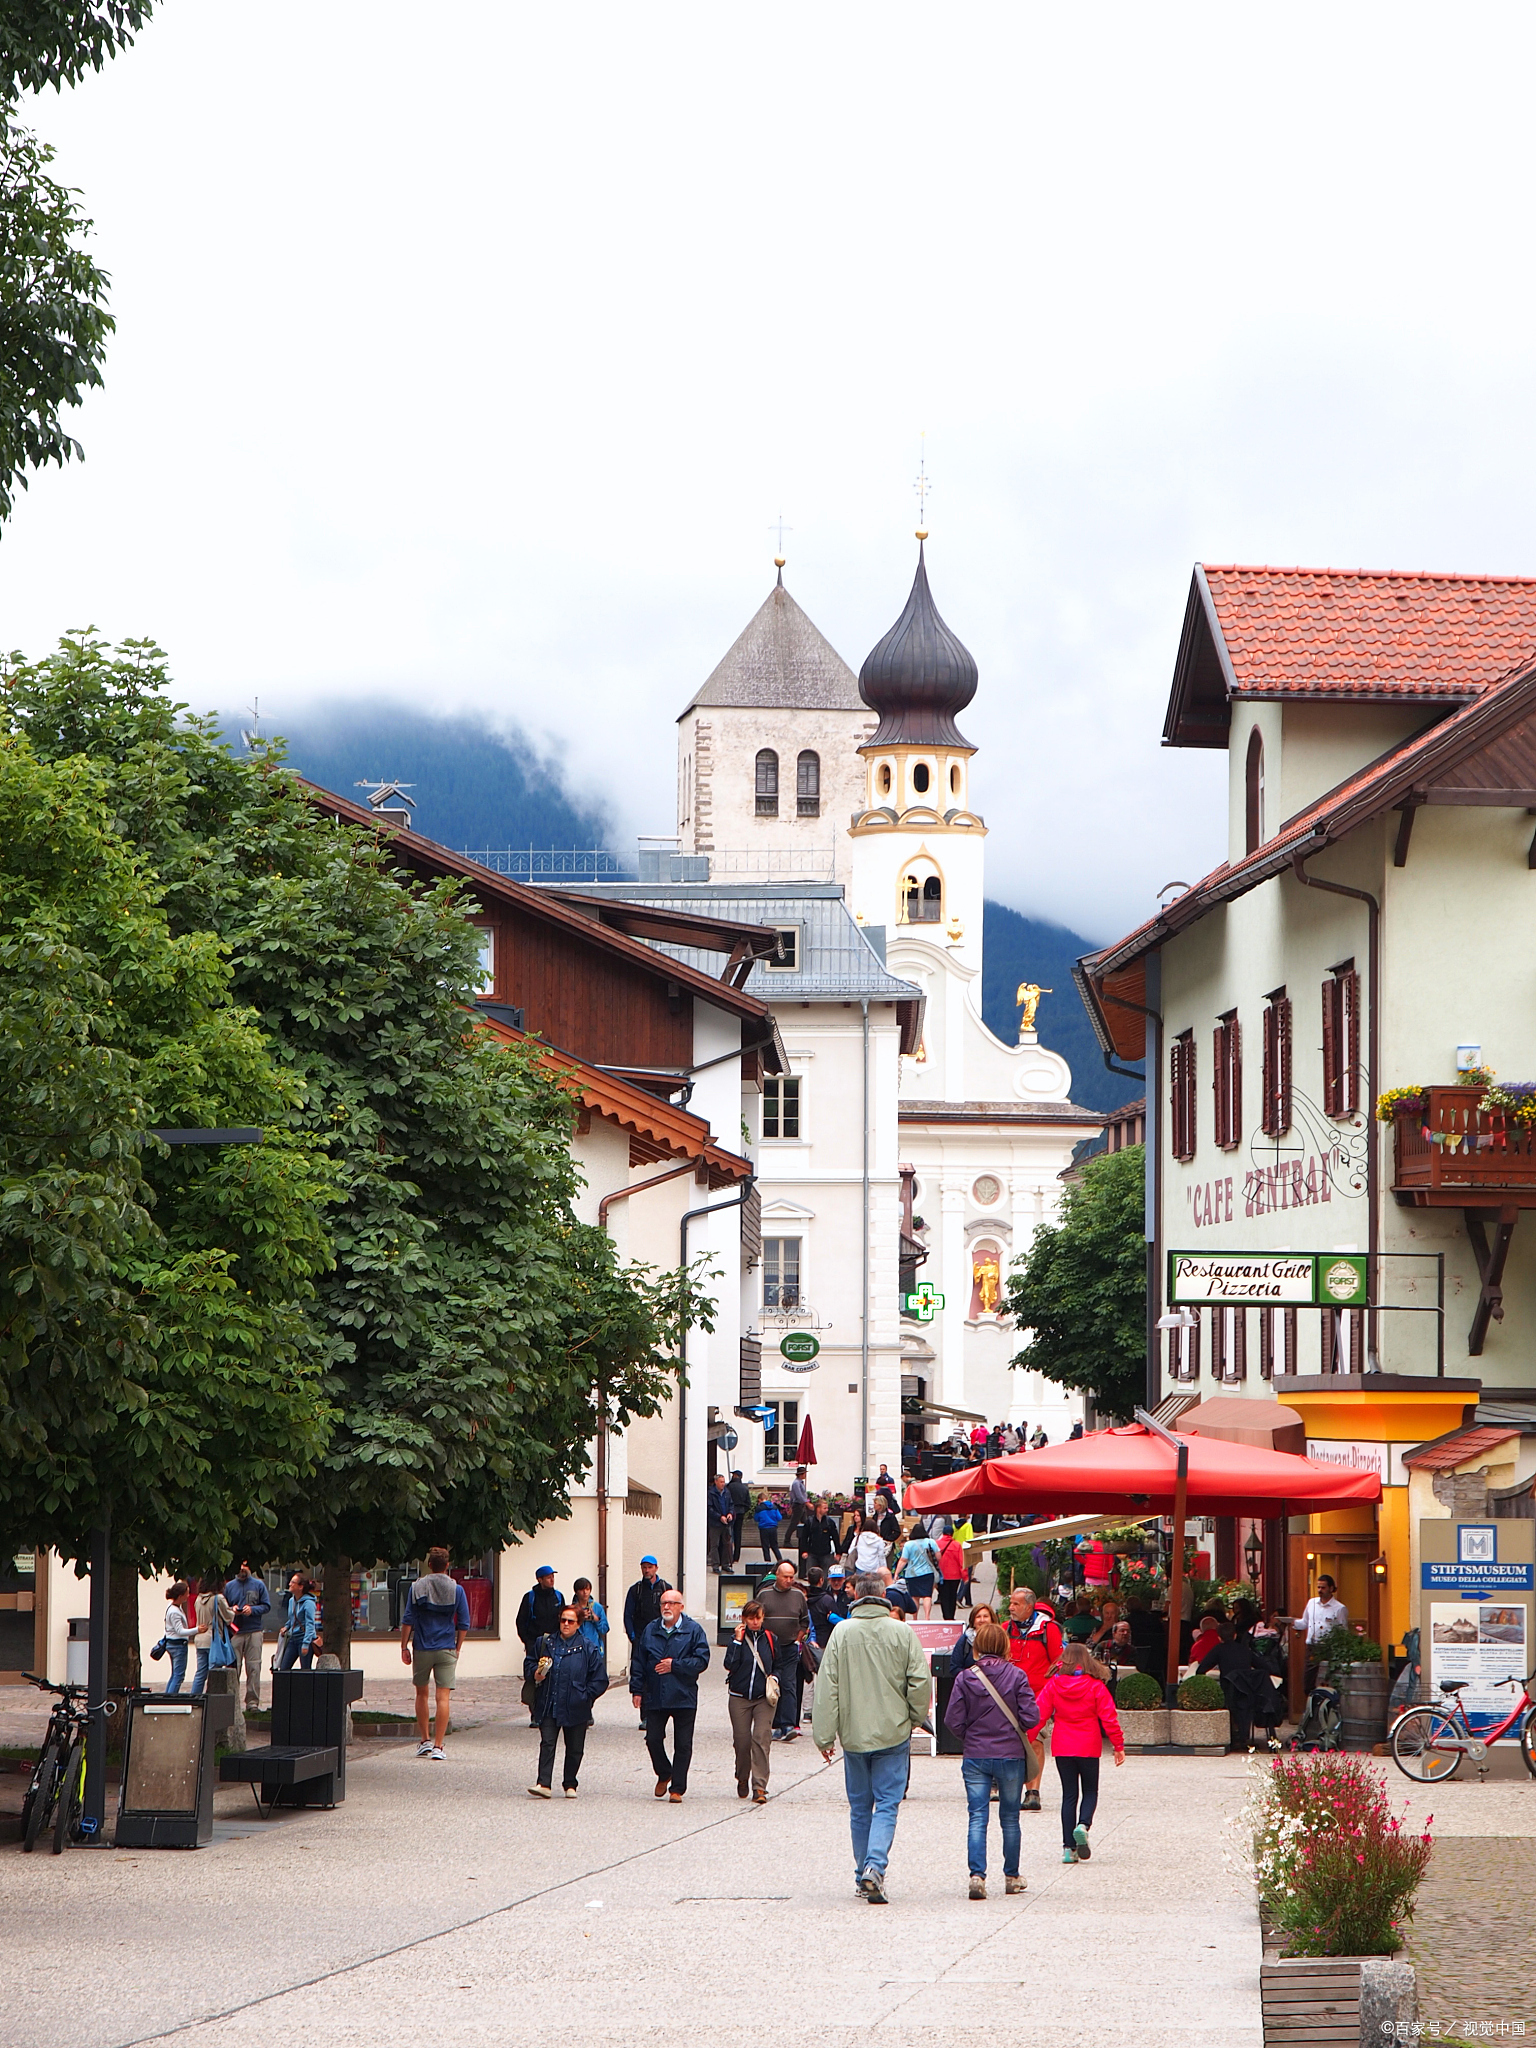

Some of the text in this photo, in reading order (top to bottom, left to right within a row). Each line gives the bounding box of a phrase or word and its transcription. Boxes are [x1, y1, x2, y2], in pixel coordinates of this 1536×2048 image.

[1176, 1258, 1312, 1278] Restaurant Grill
[1206, 1278, 1282, 1297] Pizzeria
[1329, 1276, 1357, 1285] FORST
[1431, 1565, 1527, 1575] STIFTSMUSEUM
